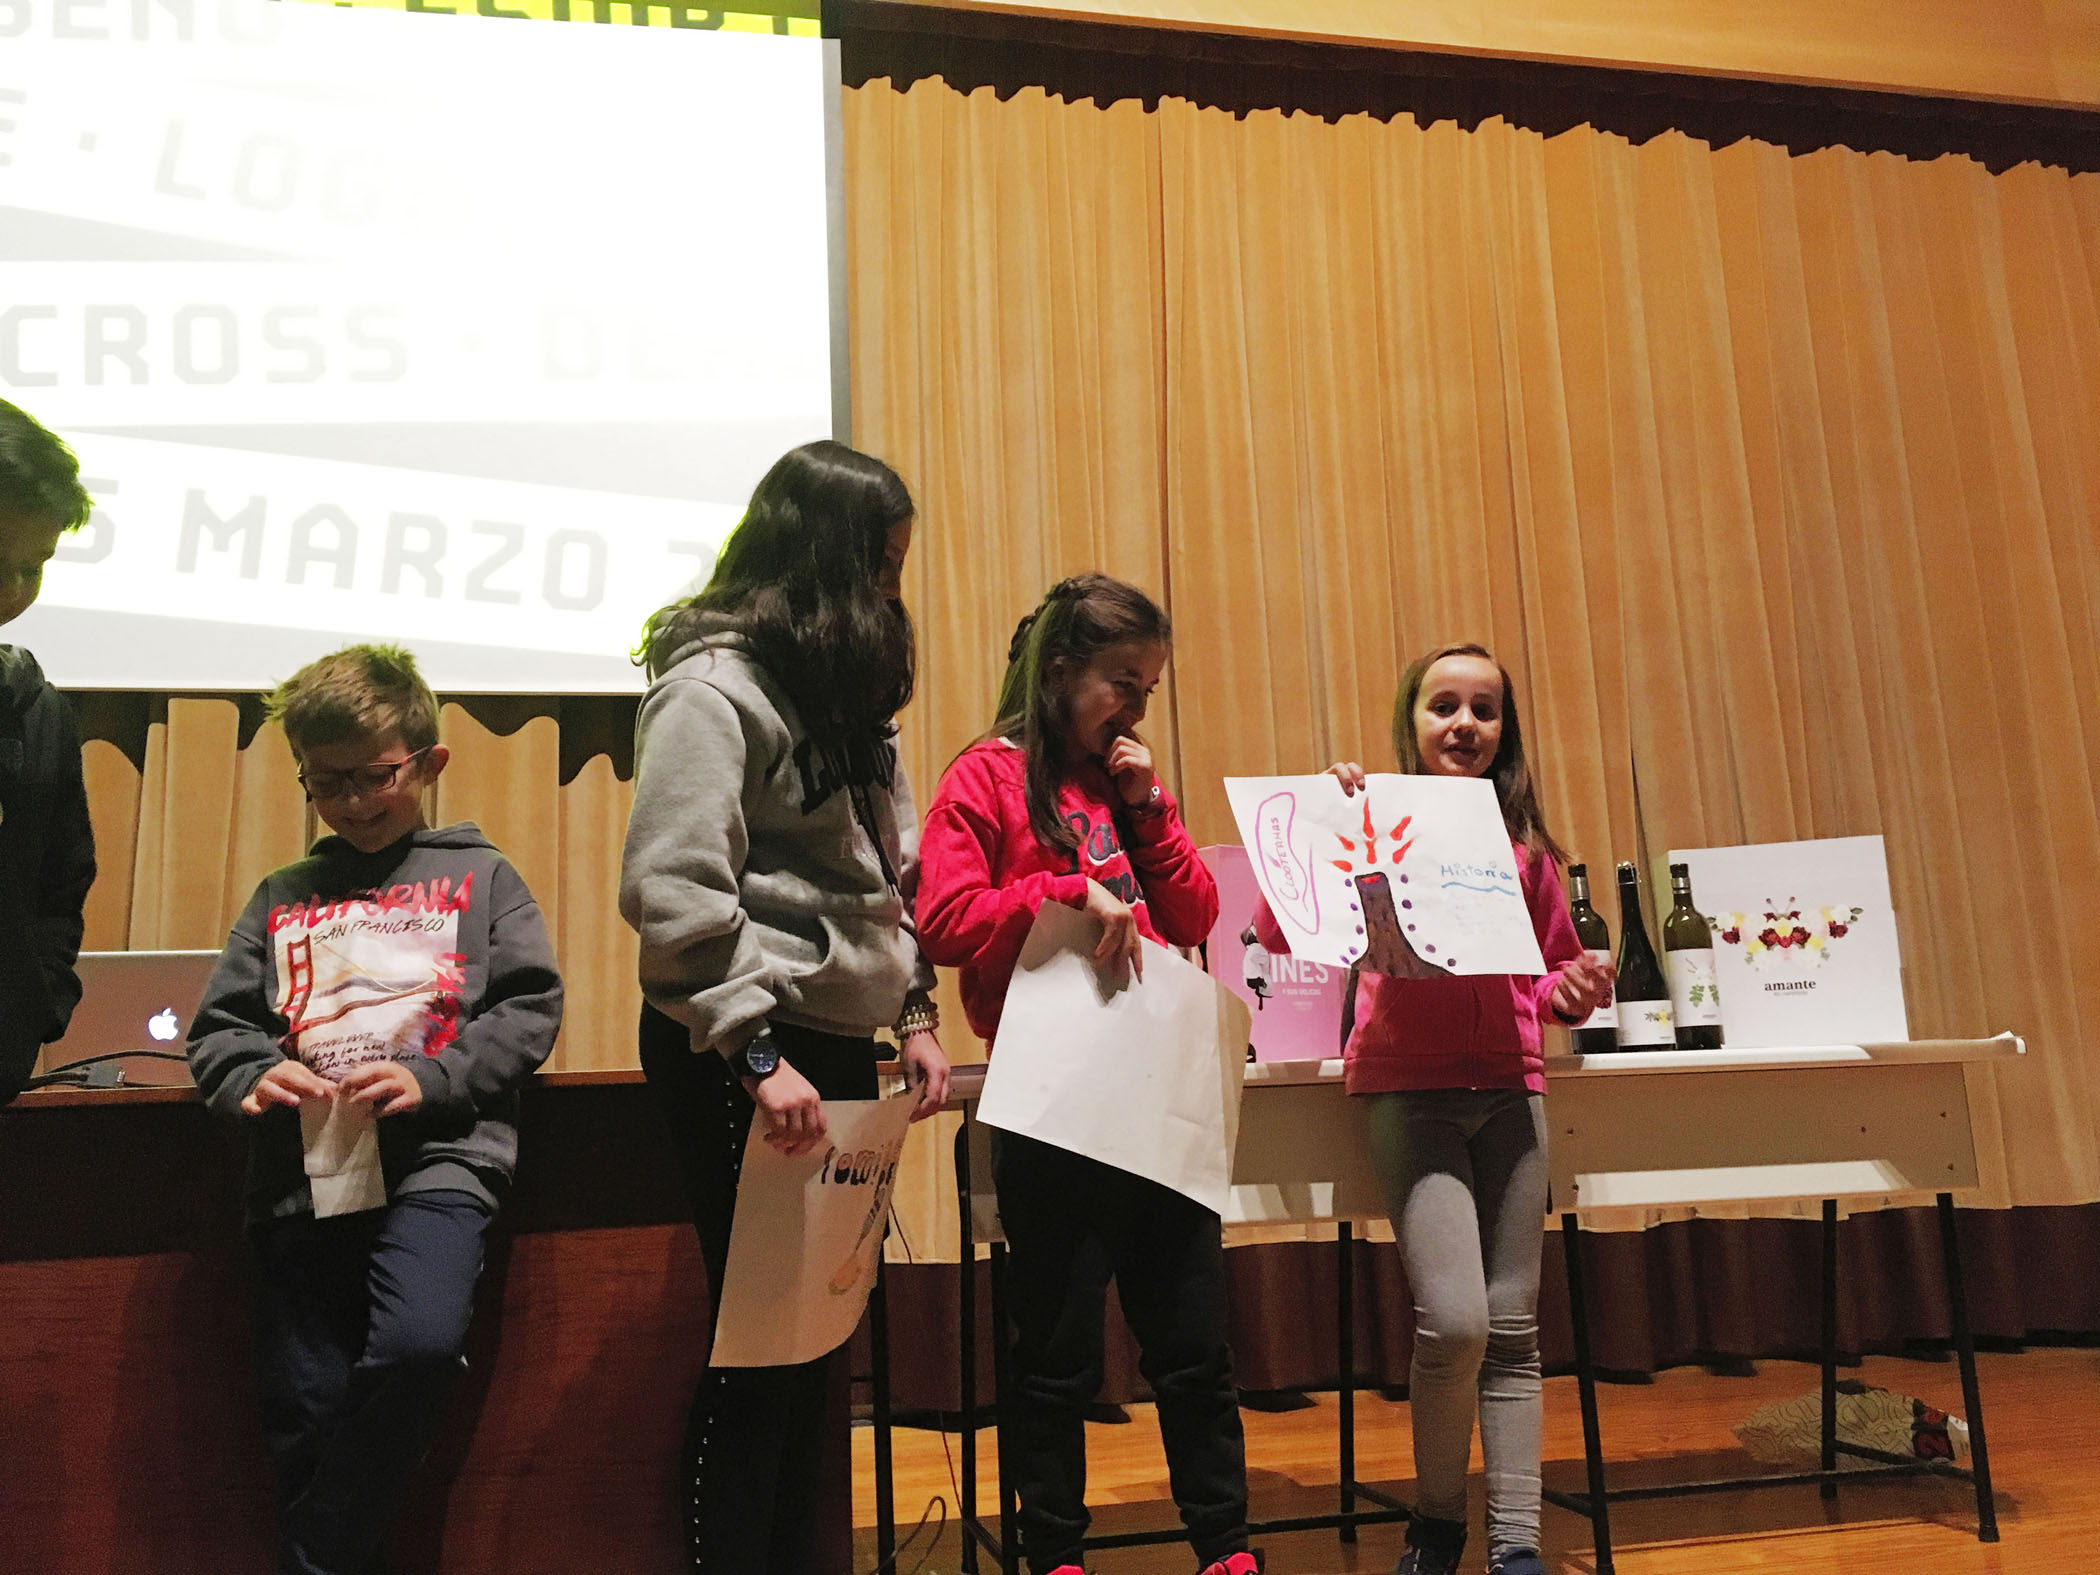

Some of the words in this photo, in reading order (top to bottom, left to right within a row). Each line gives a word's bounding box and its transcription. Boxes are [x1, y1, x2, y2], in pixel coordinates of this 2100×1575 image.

[0, 301, 409, 391] CROSS
[172, 484, 611, 614] MARZO
[313, 924, 347, 946] SAN
[350, 917, 446, 936] FRANCISCO
[1764, 979, 1817, 992] amante
